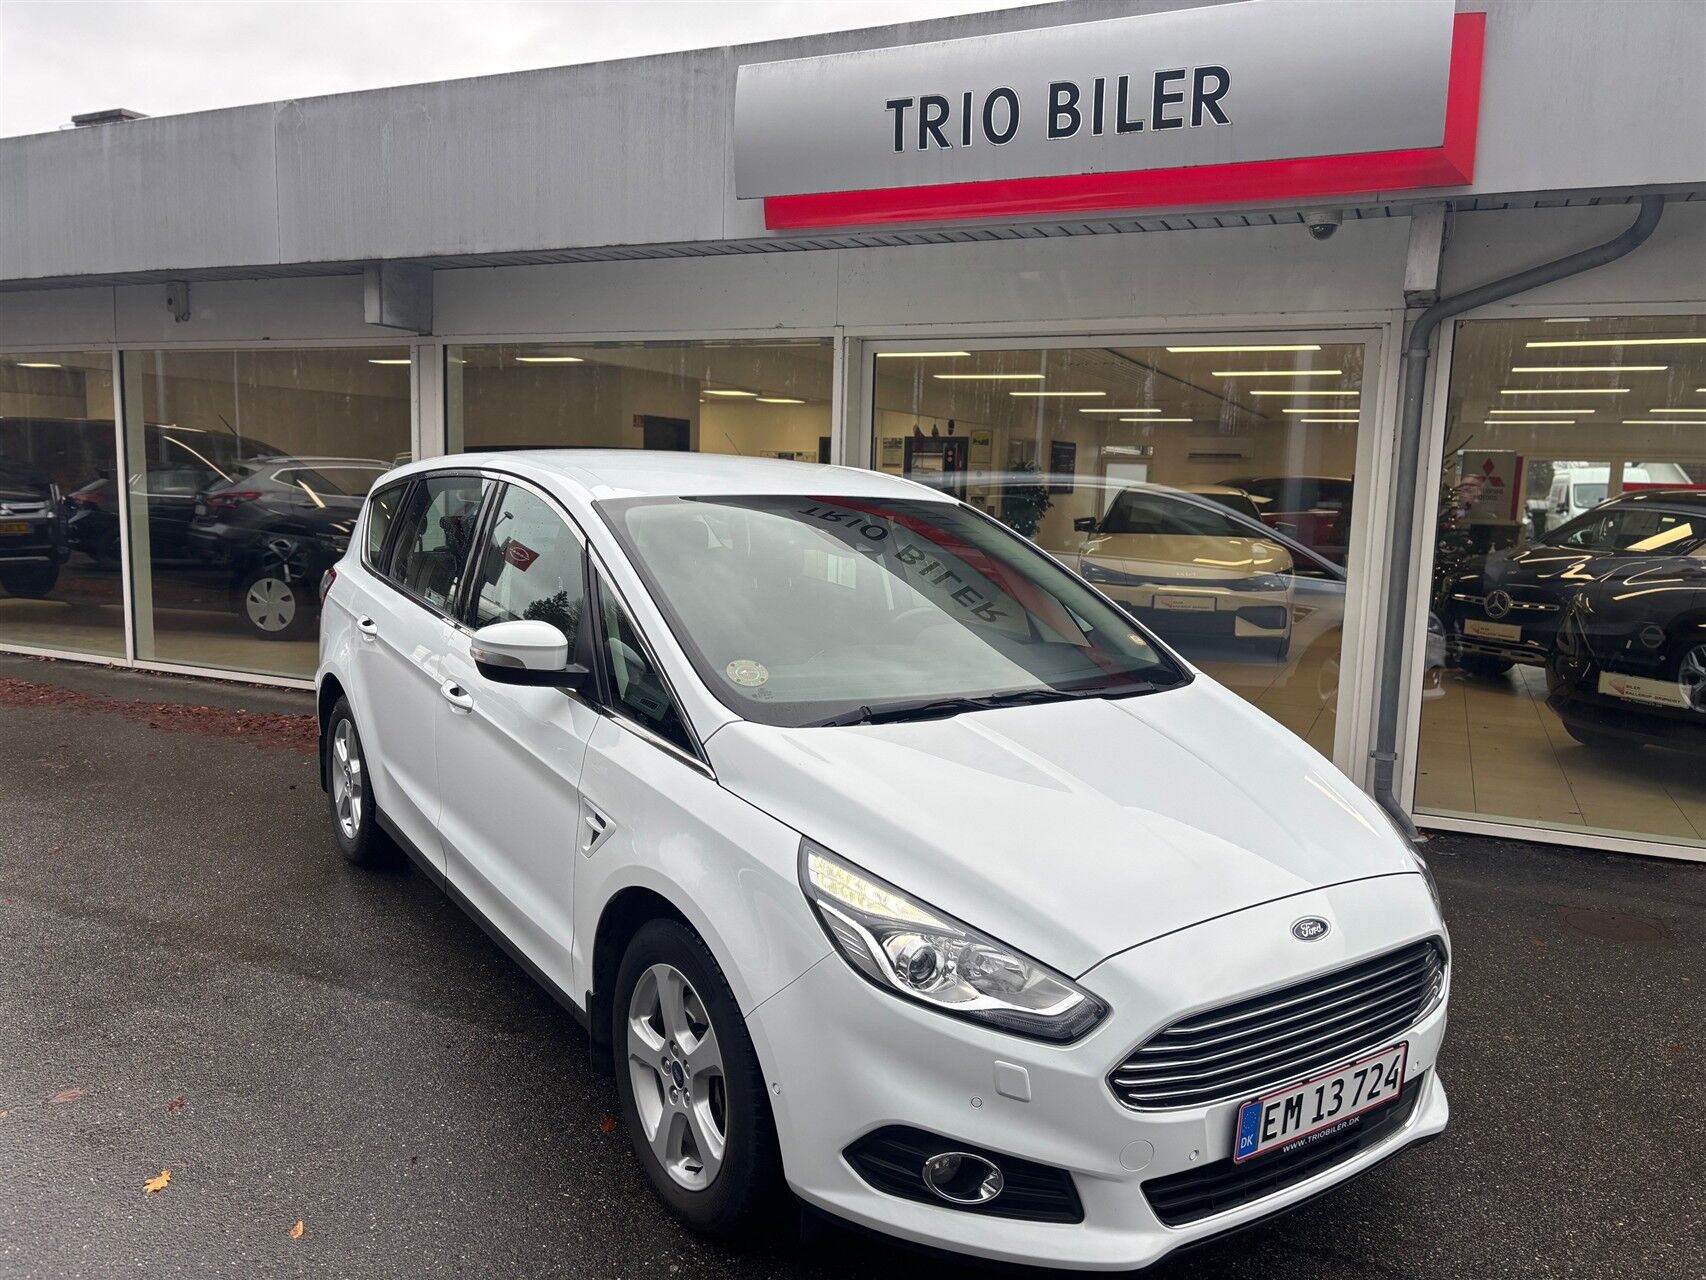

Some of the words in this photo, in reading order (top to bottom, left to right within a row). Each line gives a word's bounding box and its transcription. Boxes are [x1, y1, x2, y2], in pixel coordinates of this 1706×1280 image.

[885, 84, 1021, 153] TRIO
[1047, 64, 1232, 140] BILER
[1300, 921, 1324, 938] Ford
[1262, 1094, 1304, 1143] EM
[1311, 1078, 1345, 1124] 13
[1352, 1054, 1401, 1107] 724
[1240, 1133, 1254, 1149] DK
[1282, 1115, 1361, 1153] WWW.TRIOBILER.DK
